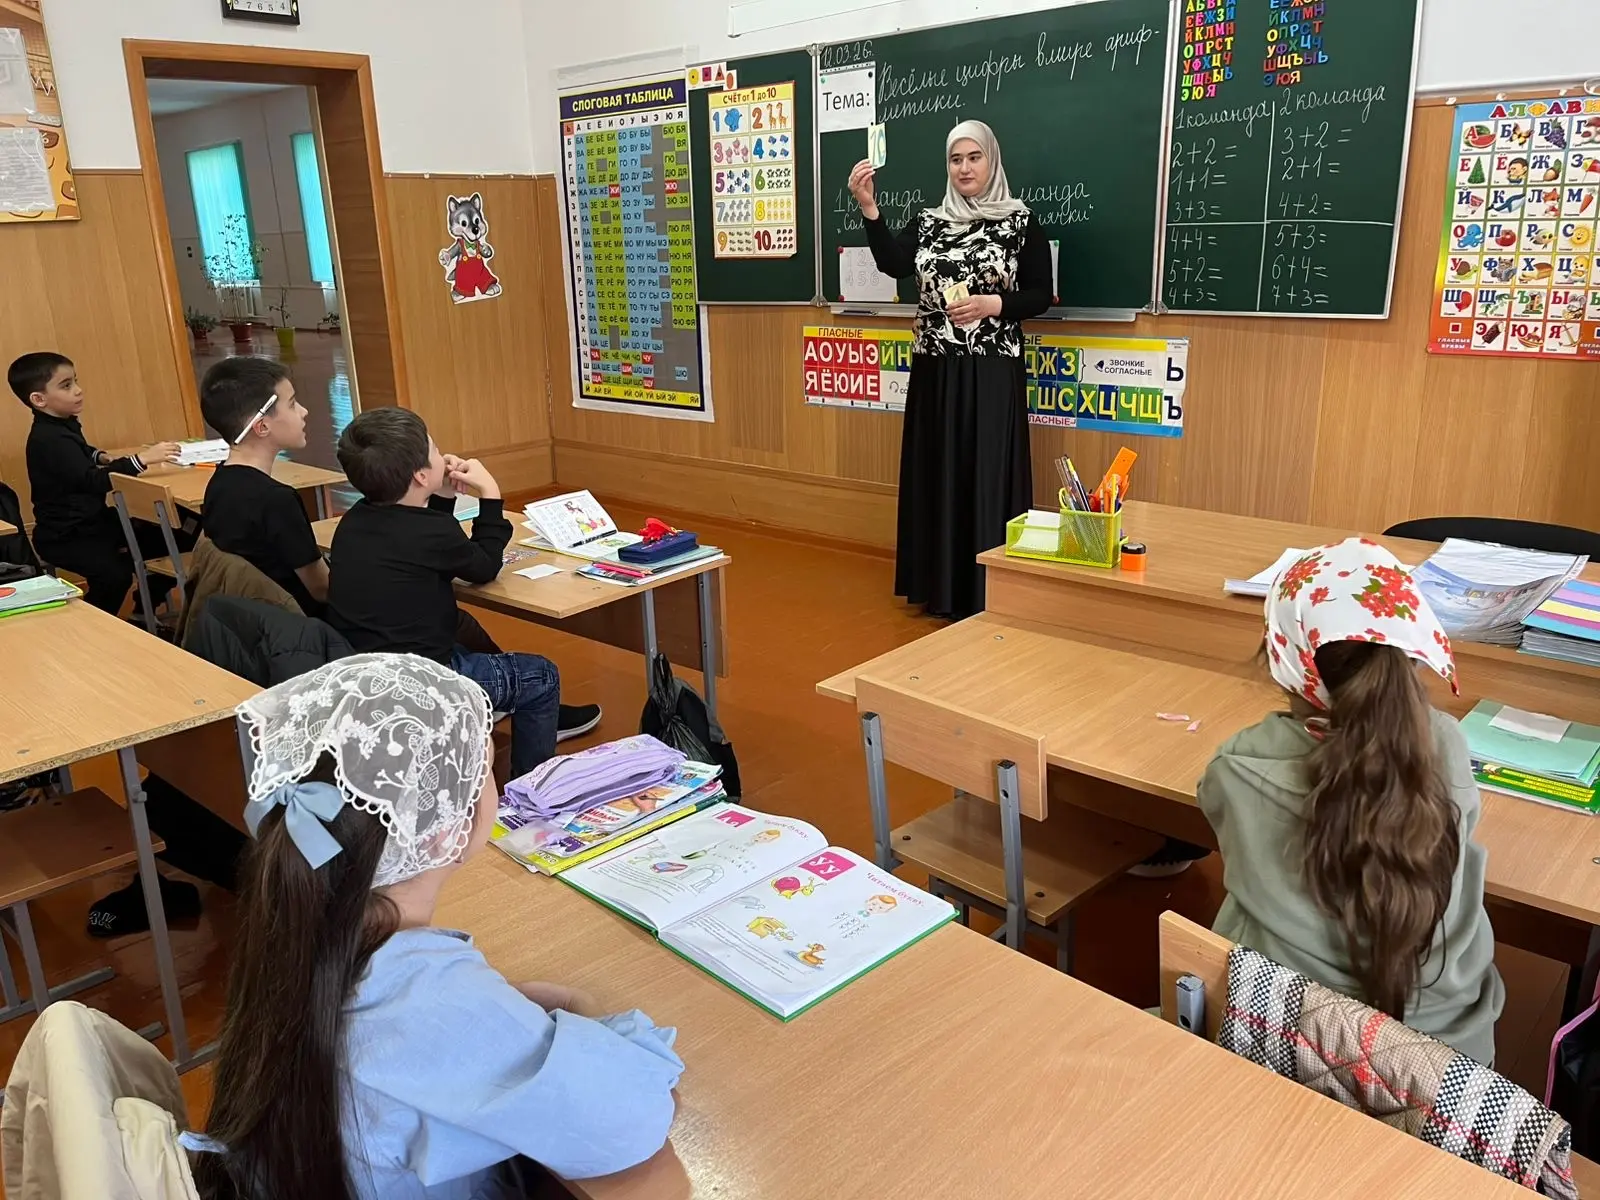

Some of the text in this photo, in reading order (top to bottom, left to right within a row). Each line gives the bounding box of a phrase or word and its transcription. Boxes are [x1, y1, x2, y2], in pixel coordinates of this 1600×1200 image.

[246, 1, 252, 9] 7
[1268, 2, 1325, 26] ЙКЛМН
[1185, 22, 1235, 43] ЙКЛМН
[1266, 20, 1324, 42] ОПРСТ
[1184, 37, 1234, 58] ОПРСТ
[572, 87, 674, 112] СЛОГОВАЯ ТАБЛИЦА
[722, 92, 742, 104] СЧЁТ
[750, 90, 755, 100] 1
[758, 92, 766, 100] до
[766, 87, 776, 98] 10
[822, 92, 870, 111] Тема:
[666, 112, 674, 120] Ю
[678, 110, 684, 118] Я
[712, 111, 720, 132] 1
[752, 107, 763, 130] 2
[664, 126, 674, 135] БЮ
[676, 125, 686, 134] БЯ
[1500, 124, 1512, 138] Б
[1538, 122, 1551, 136] В
[1576, 120, 1587, 134] Г
[714, 142, 724, 164] 3
[752, 138, 764, 160] 4
[1460, 158, 1471, 172] Е
[1496, 153, 1508, 170] Ё
[1531, 155, 1550, 169] Ж
[1571, 154, 1584, 168] З
[715, 172, 725, 192] 5
[754, 169, 766, 190] 6
[1492, 190, 1506, 204] К
[1528, 190, 1542, 203] Л
[1566, 188, 1582, 202] М
[716, 202, 726, 222] 7
[754, 200, 766, 222] 8
[1453, 224, 1465, 238] О
[1488, 224, 1502, 238] П
[1526, 224, 1538, 238] Р
[1562, 224, 1574, 237] С
[718, 231, 728, 252] 9
[754, 230, 772, 251] 10
[1450, 258, 1462, 271] У
[1484, 258, 1498, 271] Ф
[1522, 258, 1536, 272] Х
[1558, 258, 1572, 274] Ц
[1444, 289, 1462, 303] Ш
[1478, 290, 1498, 304] Щ
[1551, 291, 1570, 305] Ы
[818, 328, 864, 338] ГЛАСНЫЕ
[1476, 322, 1488, 336] Э
[1511, 324, 1528, 337] Ю
[1548, 325, 1562, 339] Я
[1109, 359, 1145, 368] ЗВОНКИЕ
[1166, 356, 1184, 382] Ь
[1104, 367, 1152, 376] СОГЛАСНЫЕ
[1164, 396, 1183, 420] Ъ
[1028, 415, 1072, 426] ЛАСНЫЕ
[866, 872, 898, 895] Читаем
